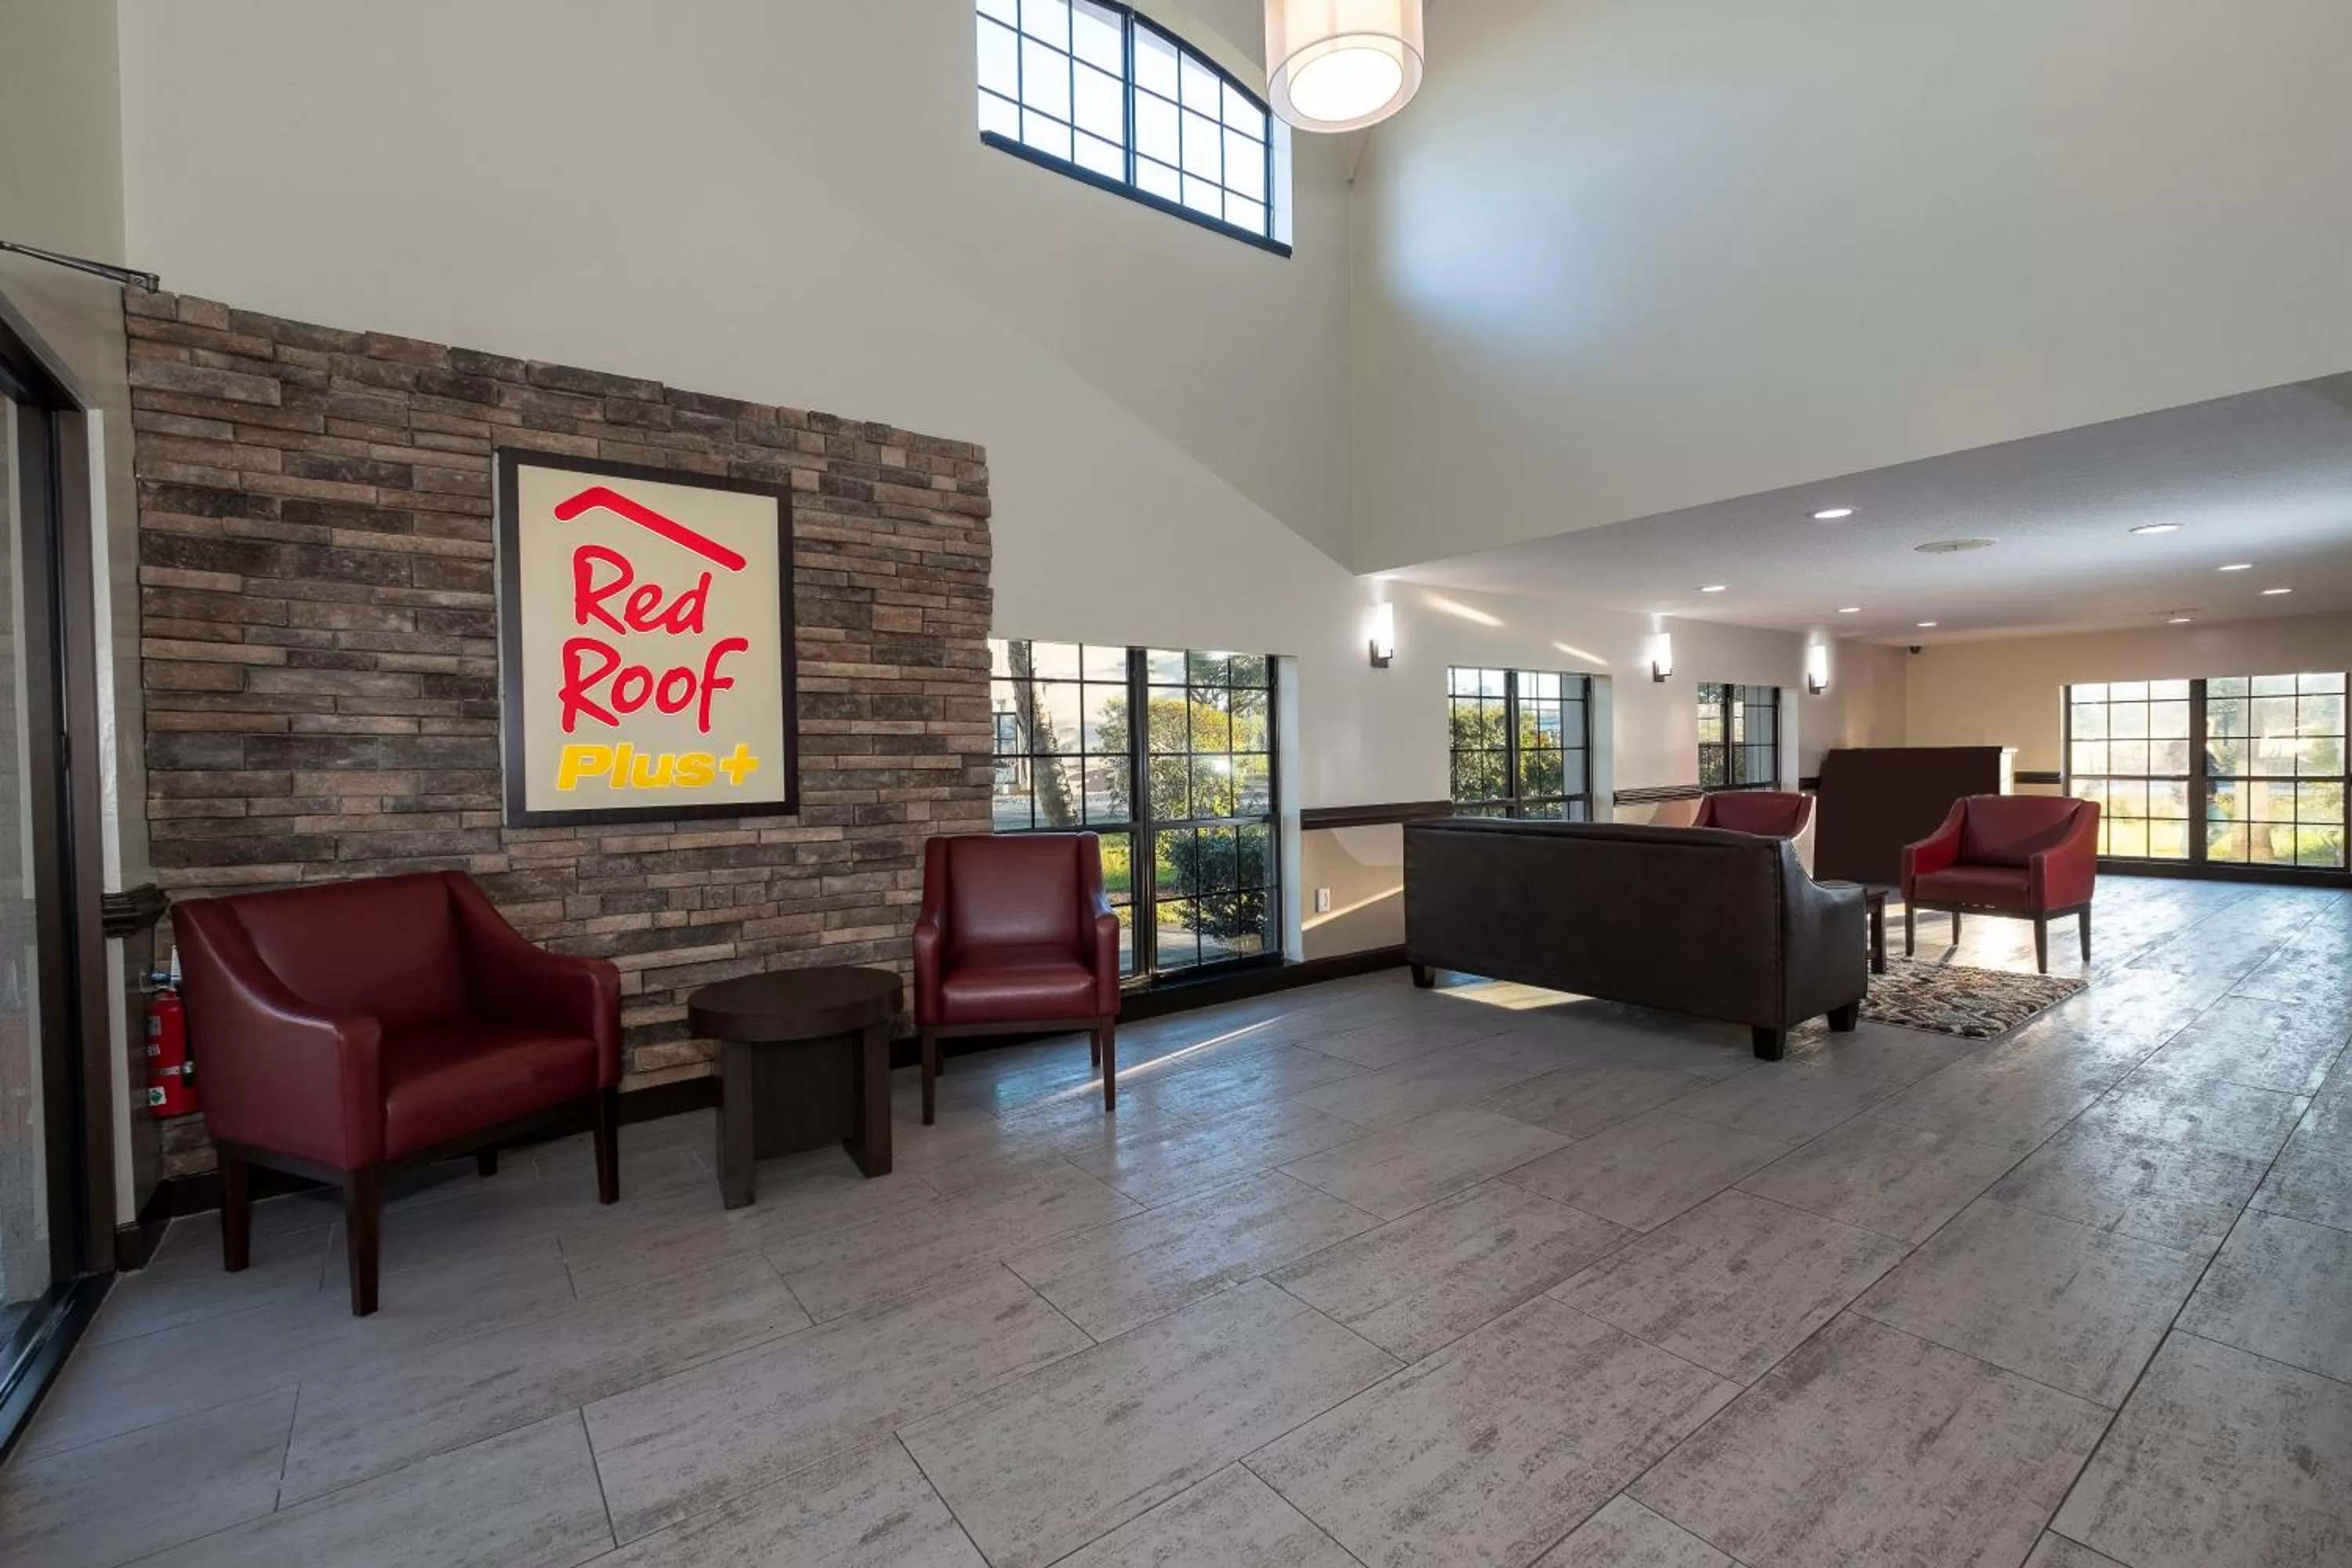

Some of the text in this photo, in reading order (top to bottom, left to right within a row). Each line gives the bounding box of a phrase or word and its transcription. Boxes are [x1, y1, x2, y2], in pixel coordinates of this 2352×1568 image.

[573, 545, 712, 635] Red
[557, 637, 749, 733] Roof
[557, 742, 759, 790] Plus+
